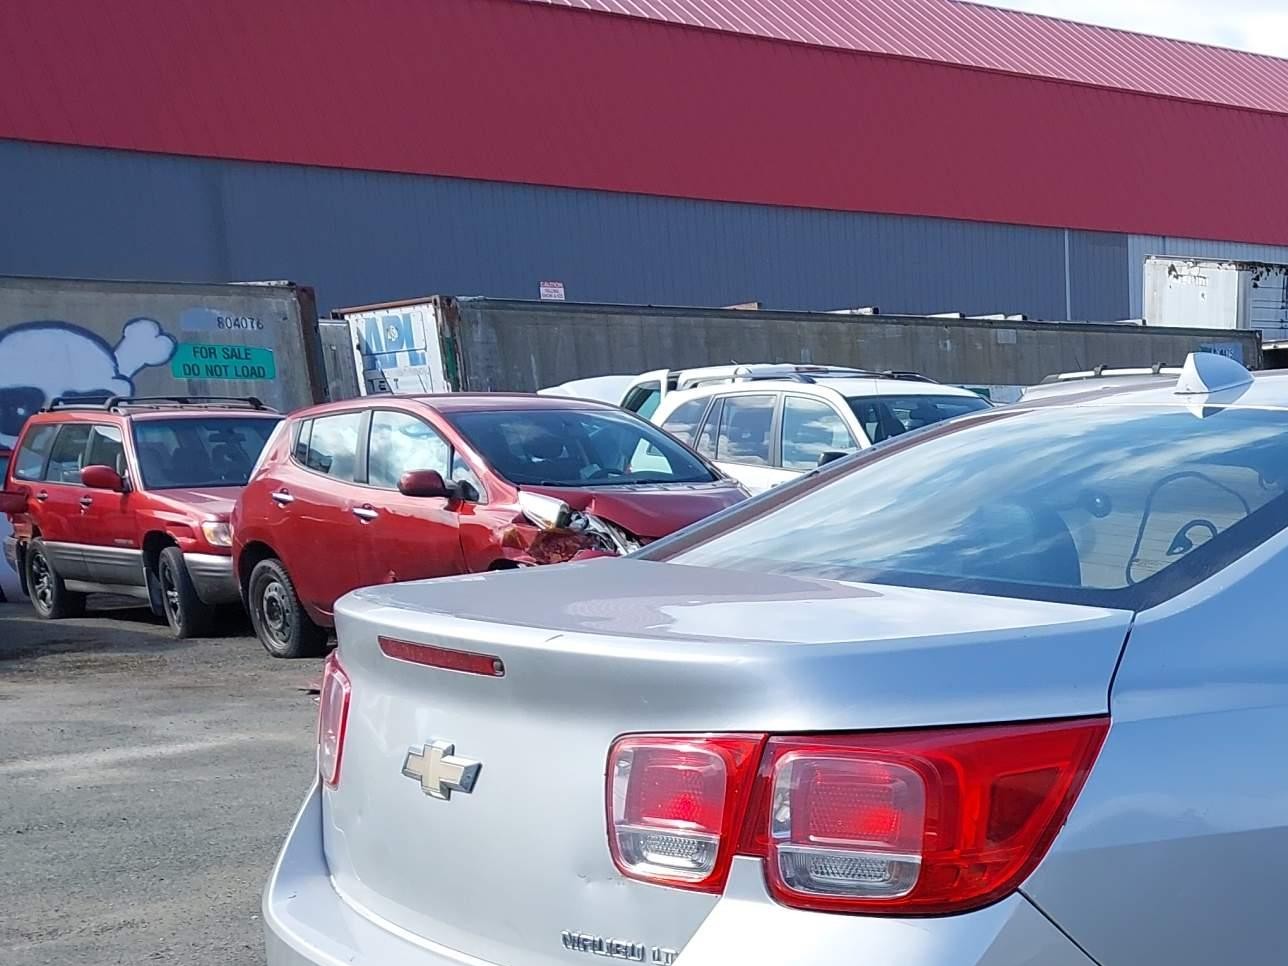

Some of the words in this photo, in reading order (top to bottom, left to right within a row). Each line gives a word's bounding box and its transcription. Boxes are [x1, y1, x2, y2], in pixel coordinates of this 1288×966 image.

[216, 316, 264, 330] 804076
[363, 313, 427, 370] APL
[192, 346, 217, 360] FOR
[222, 347, 251, 361] SALE
[182, 363, 201, 377] DO
[205, 364, 229, 377] NOT
[234, 364, 266, 379] LOAD
[560, 930, 647, 962] MALIBU
[651, 946, 680, 966] LT
